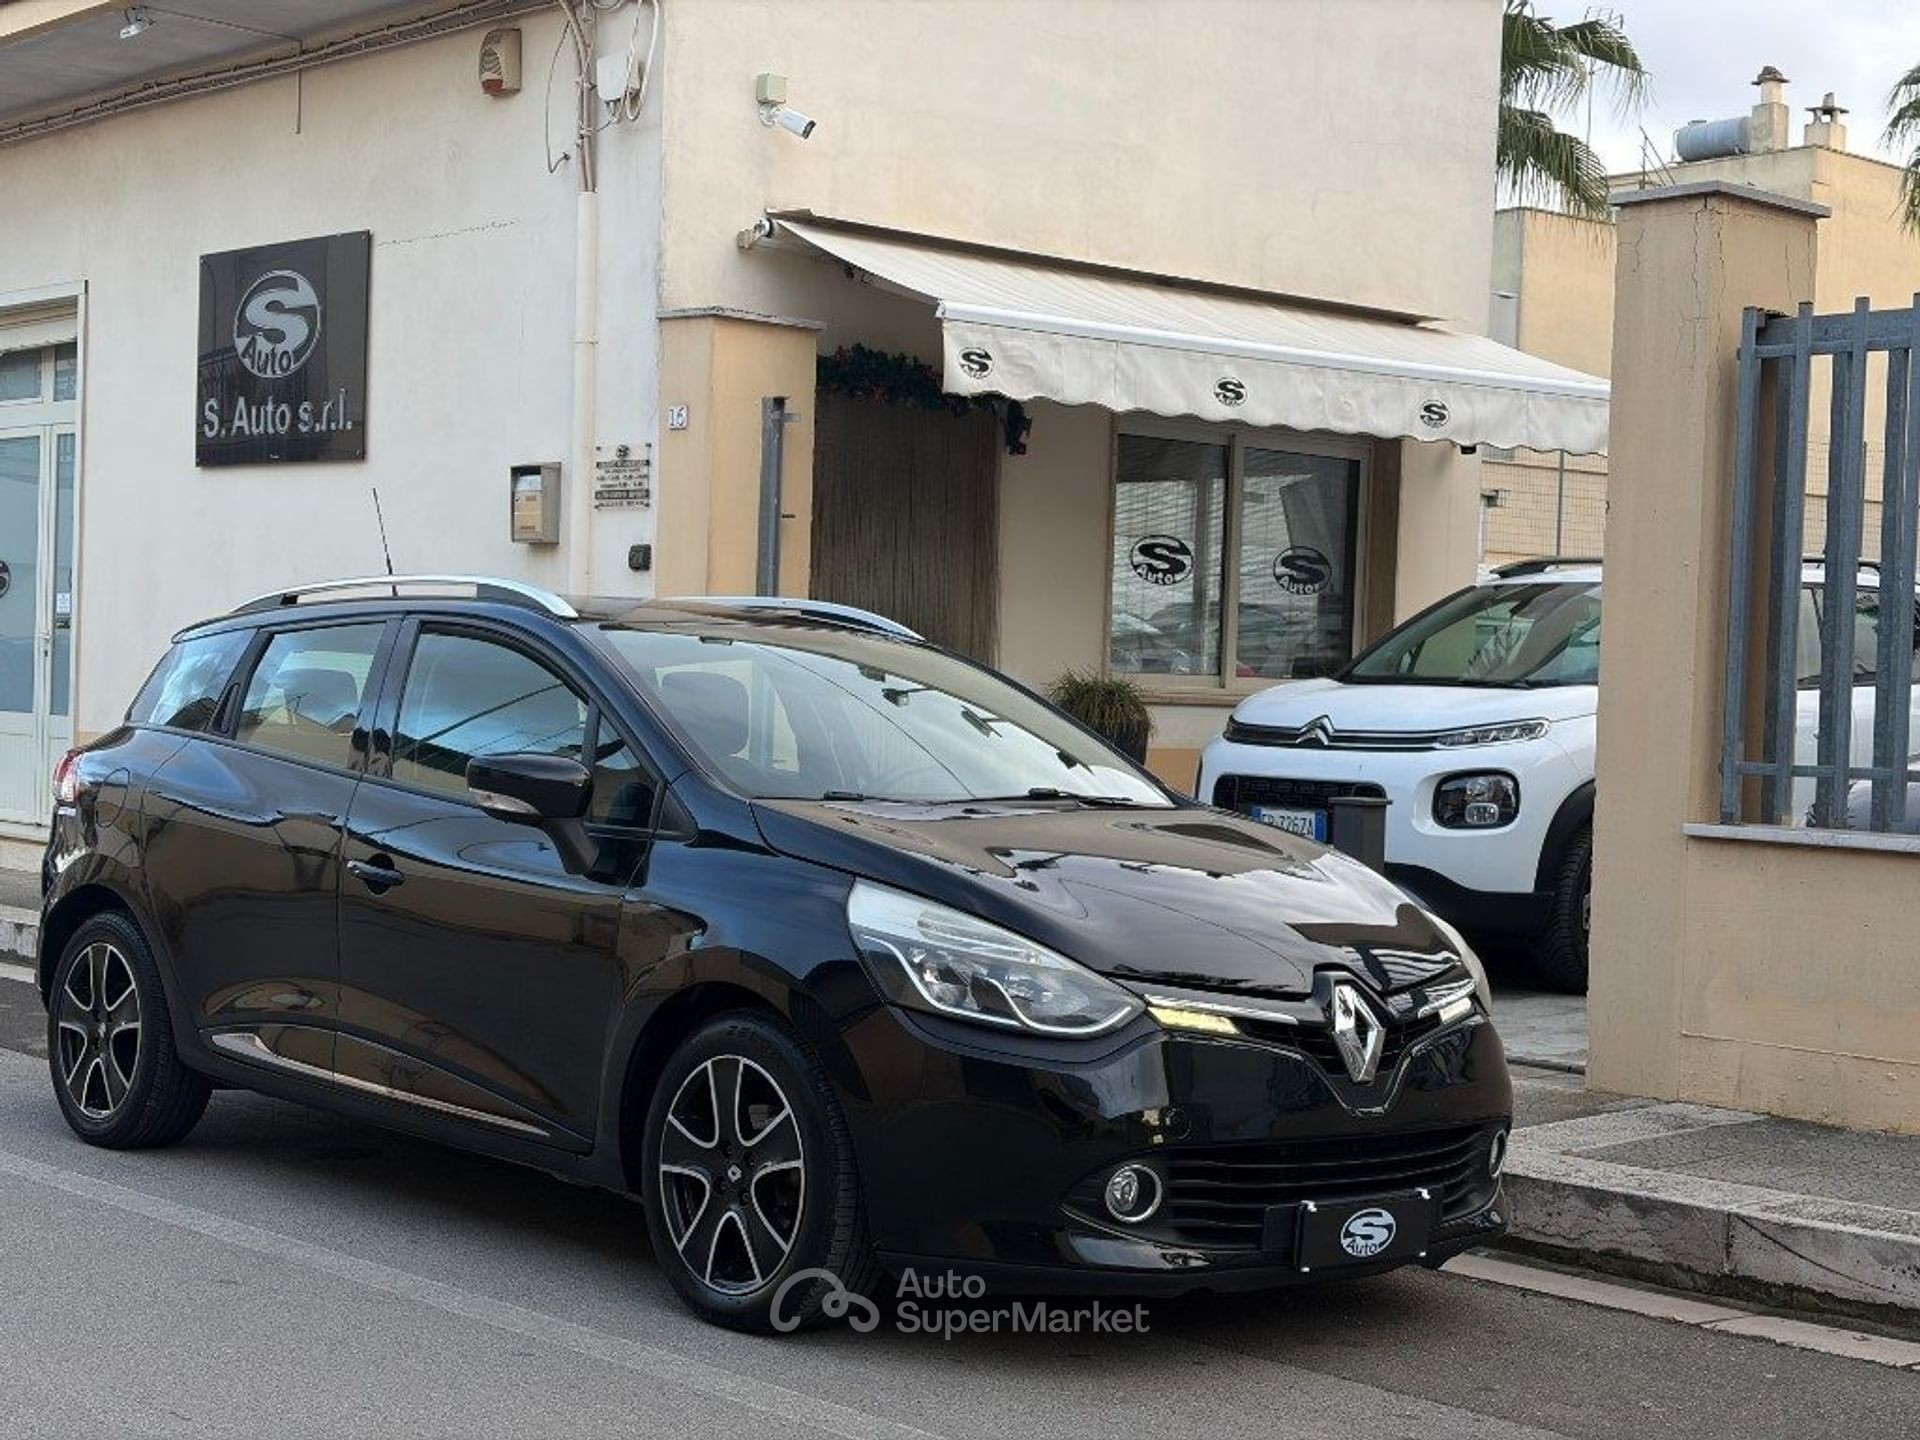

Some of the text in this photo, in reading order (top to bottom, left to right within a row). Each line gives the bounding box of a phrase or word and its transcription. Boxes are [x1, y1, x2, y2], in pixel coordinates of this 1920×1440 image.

[235, 273, 318, 353] S
[238, 335, 294, 375] Auto
[203, 387, 353, 438] S. Auto s.r.l.
[1136, 563, 1174, 585] Auto
[1279, 575, 1315, 595] Auto
[1341, 1209, 1396, 1243] S
[1345, 1237, 1379, 1255] Auto
